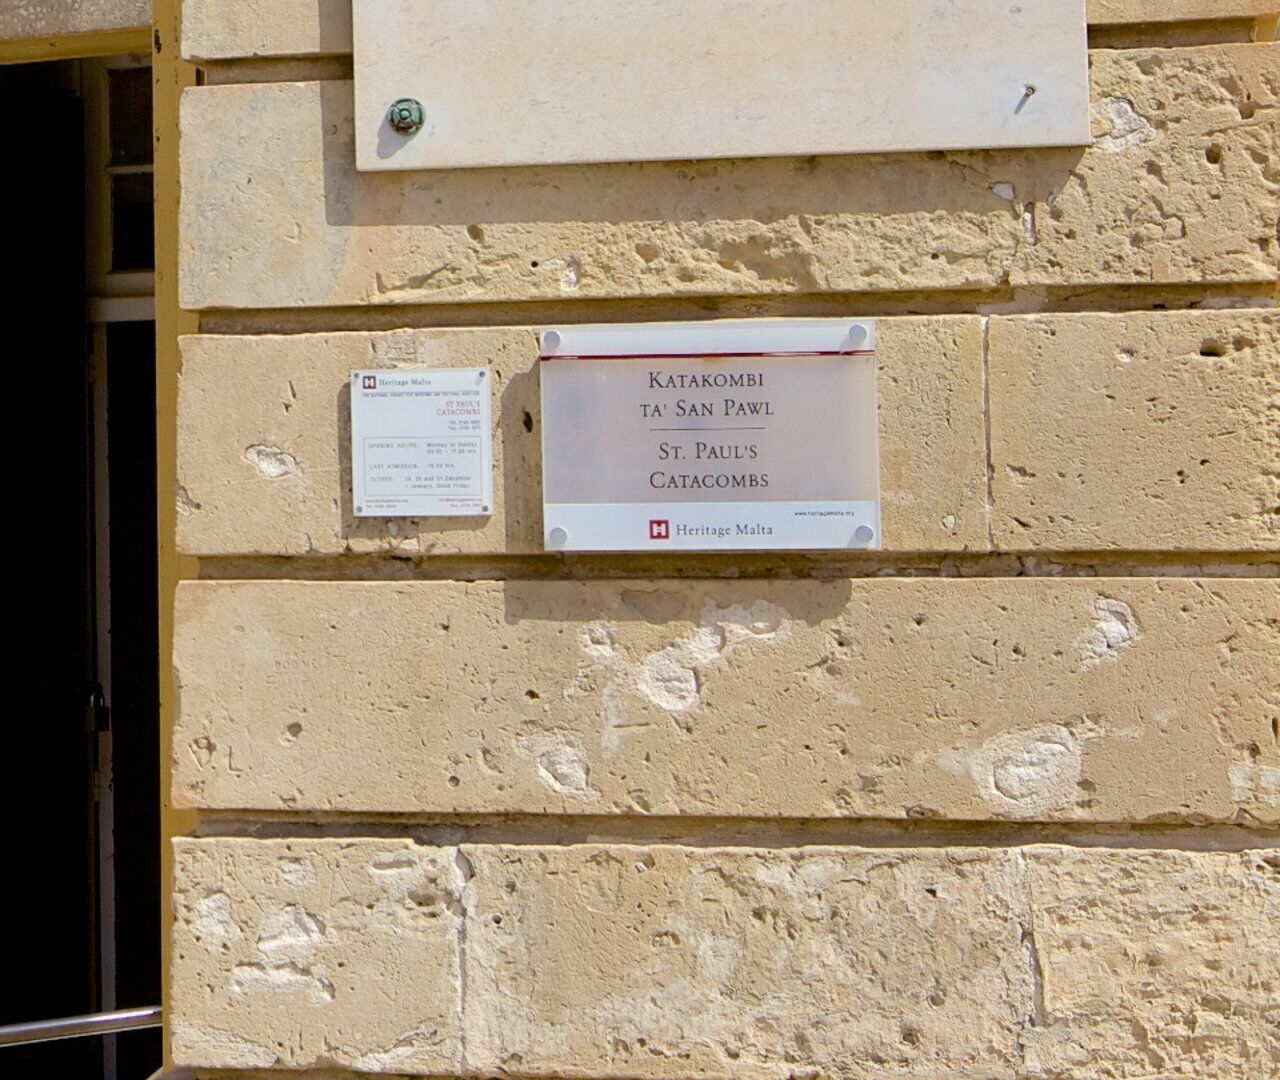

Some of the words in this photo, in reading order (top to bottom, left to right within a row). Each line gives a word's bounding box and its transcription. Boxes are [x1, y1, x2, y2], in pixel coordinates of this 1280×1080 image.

[648, 371, 765, 389] KATAKOMBI
[675, 399, 714, 417] SAN
[723, 399, 775, 417] PAWL
[695, 441, 758, 460] PAUL'S
[649, 471, 769, 489] CATACOMBS
[676, 523, 732, 538] Heritage
[736, 523, 774, 536] Malta
